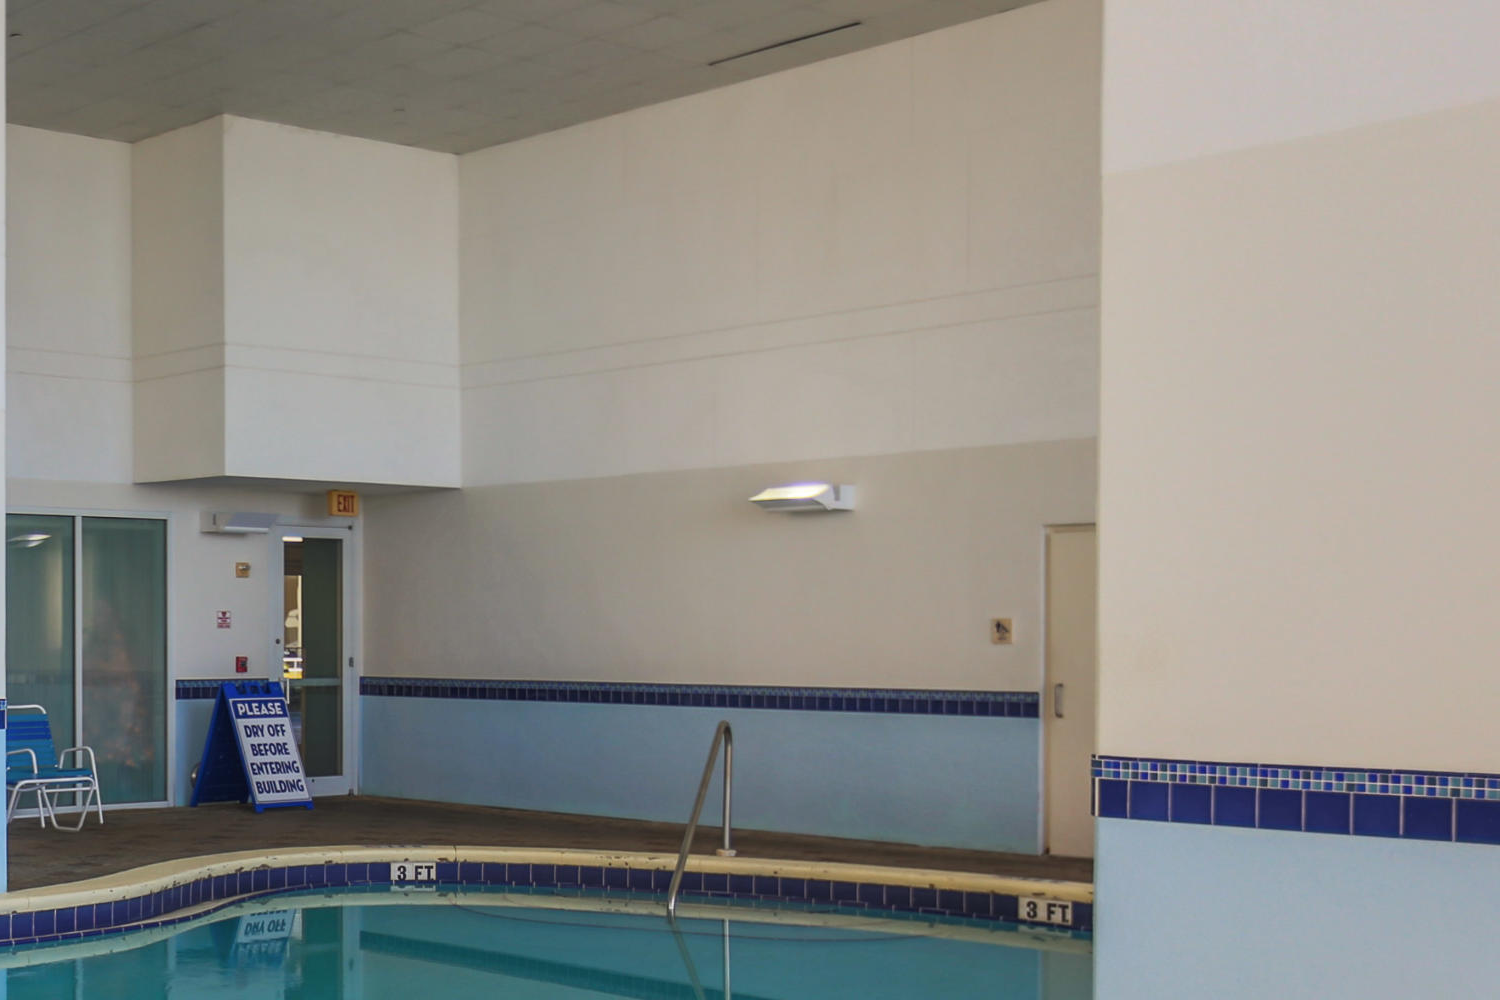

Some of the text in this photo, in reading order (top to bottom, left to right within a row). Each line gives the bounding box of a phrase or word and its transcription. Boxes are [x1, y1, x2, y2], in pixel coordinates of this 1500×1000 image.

[337, 495, 354, 512] EXIT
[237, 702, 283, 716] PLEASE
[244, 724, 286, 737] DRY OFF
[250, 743, 290, 756] BEFORE
[250, 760, 300, 775] ENTERING
[256, 779, 304, 794] BUILDING
[397, 865, 406, 880] 3
[1026, 900, 1037, 919] 3
